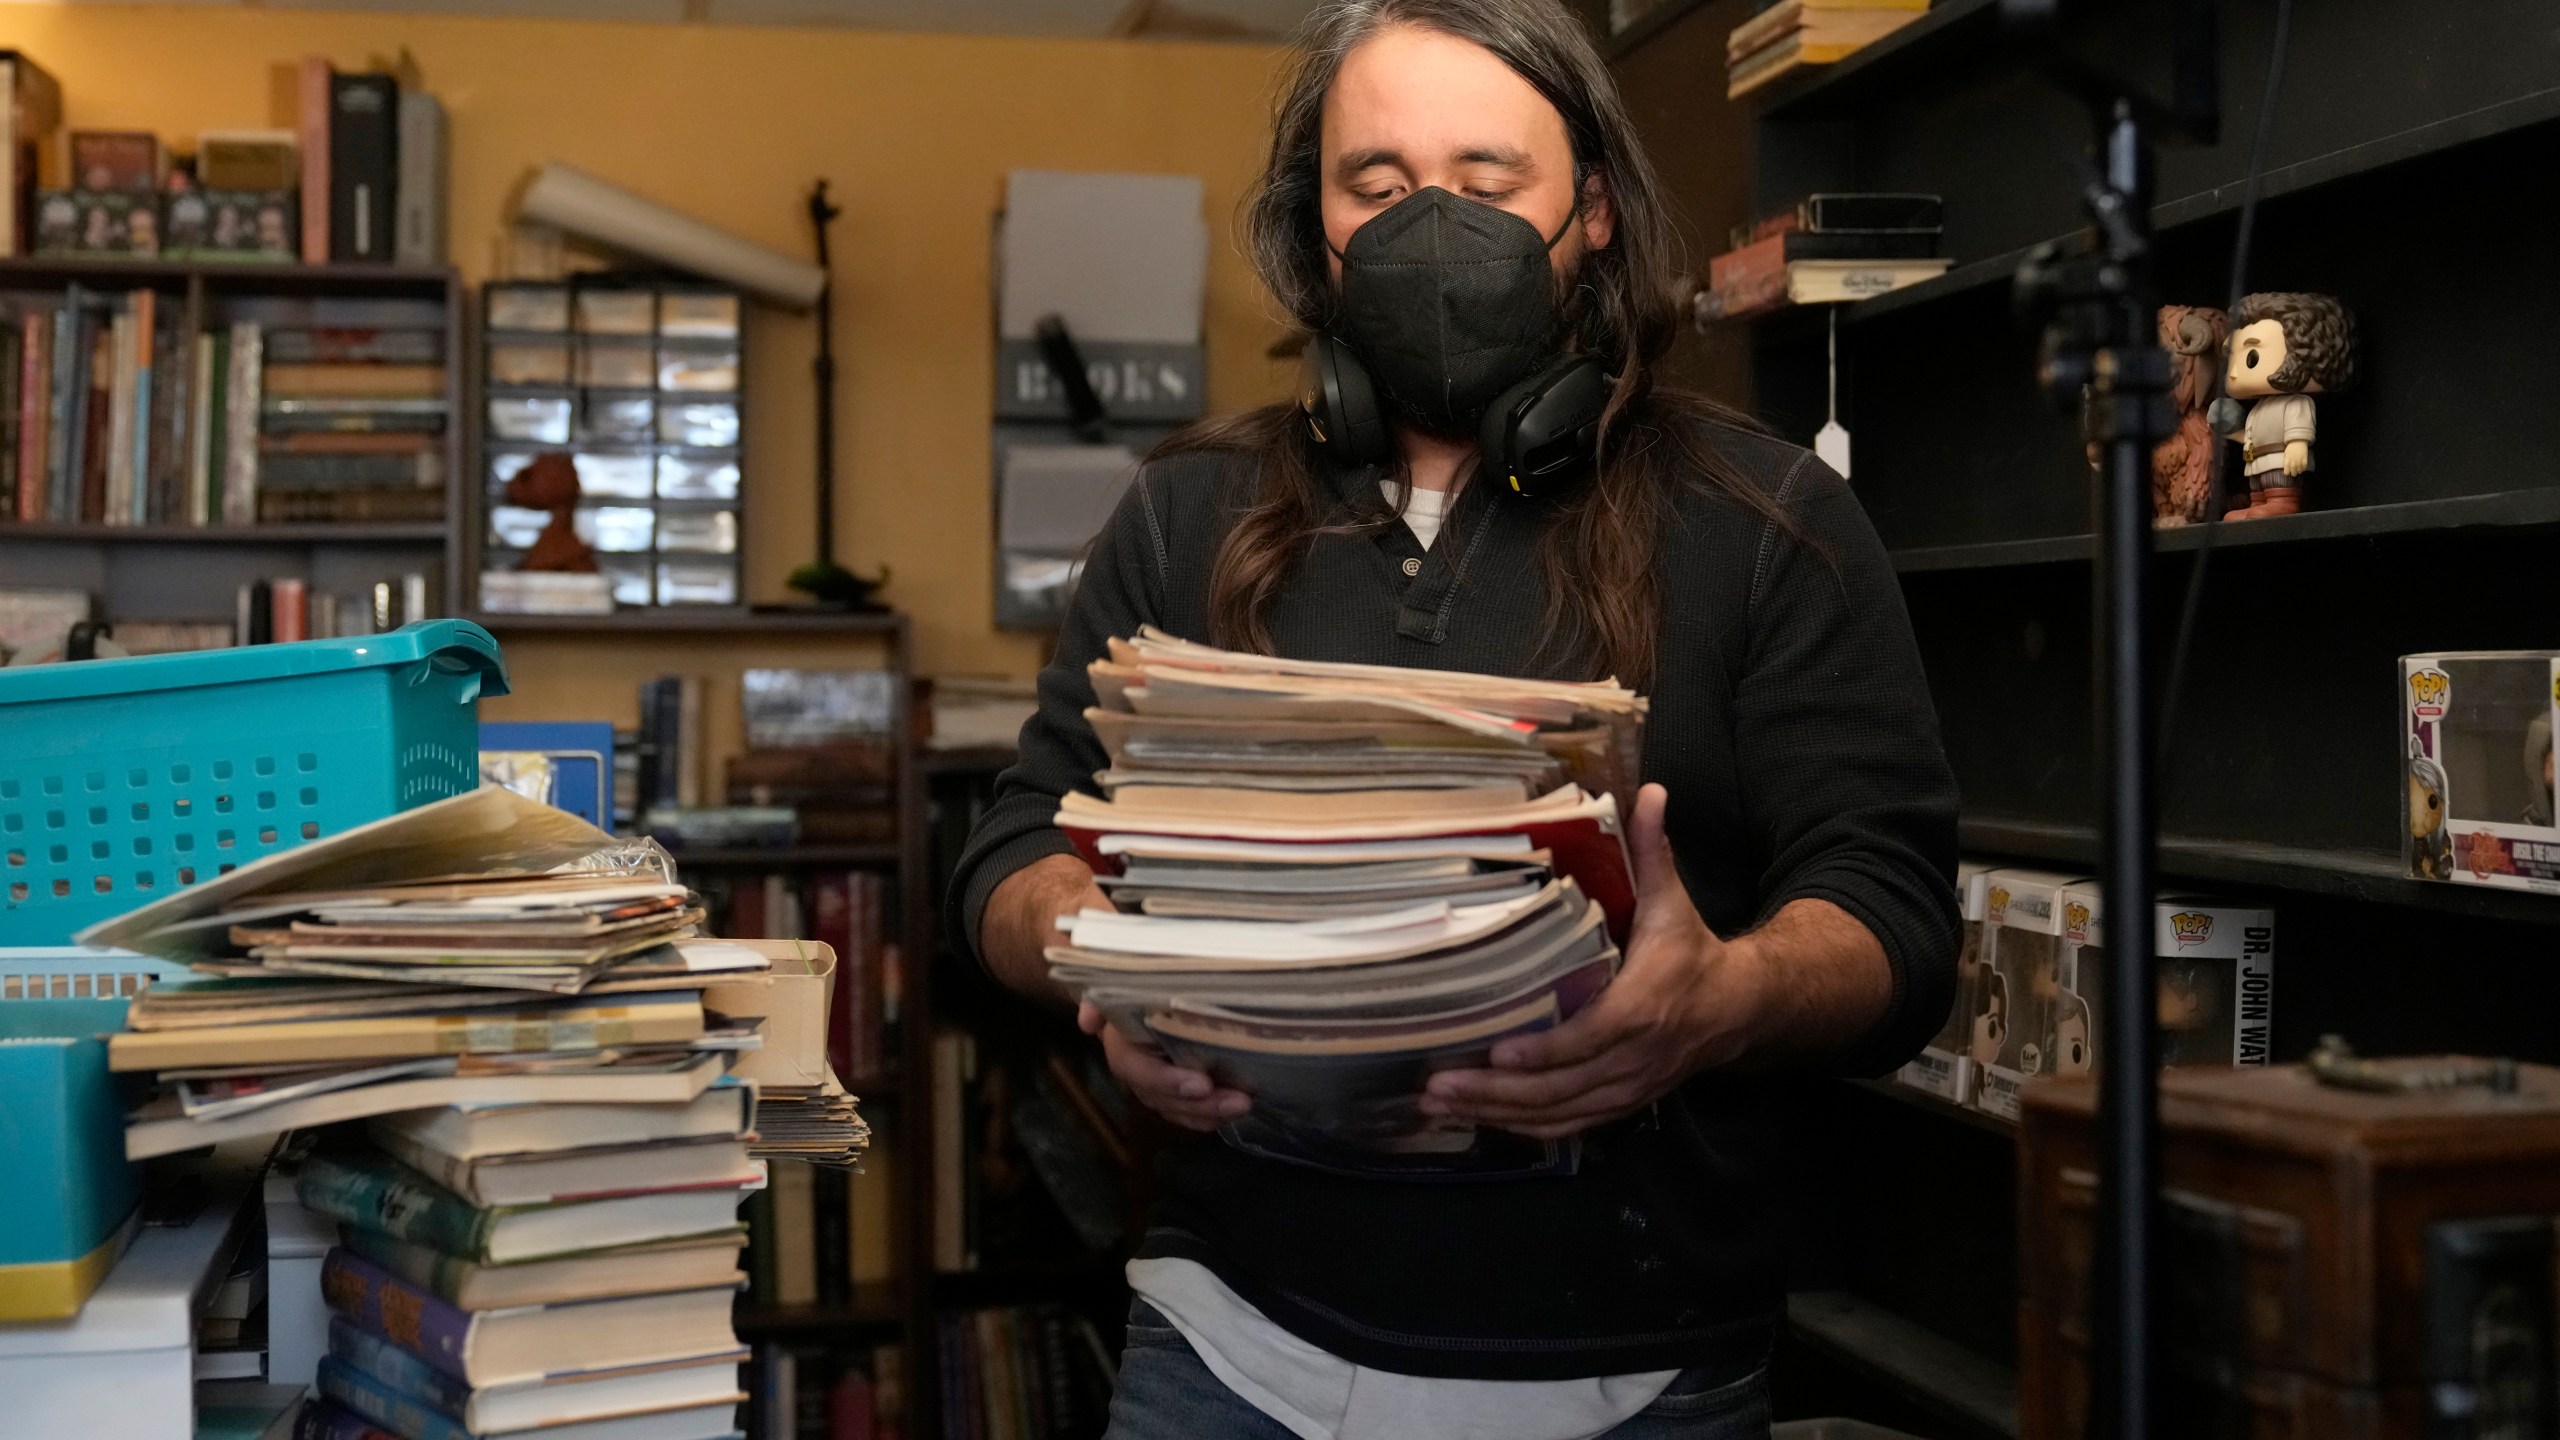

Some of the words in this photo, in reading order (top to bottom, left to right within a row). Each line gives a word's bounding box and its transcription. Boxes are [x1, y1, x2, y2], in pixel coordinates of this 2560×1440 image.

[2409, 672, 2448, 706] POP!
[2065, 903, 2089, 932] POP!
[2170, 912, 2213, 936] POP!
[2243, 926, 2271, 960] DR.
[2240, 966, 2269, 1020] JOHN
